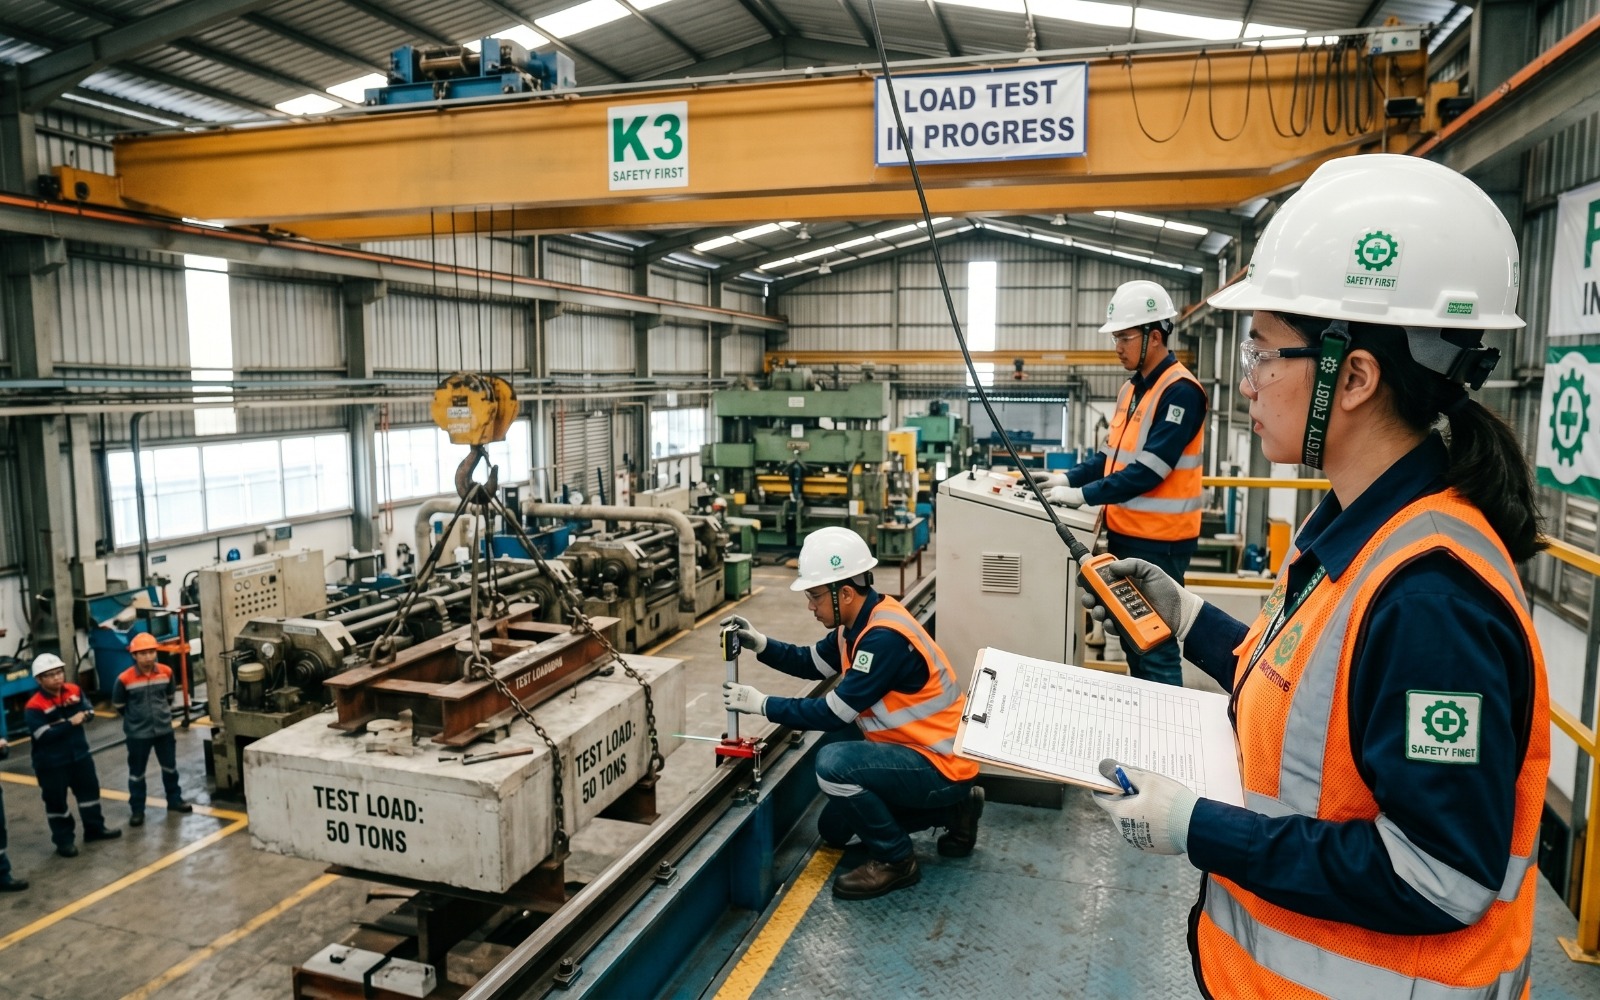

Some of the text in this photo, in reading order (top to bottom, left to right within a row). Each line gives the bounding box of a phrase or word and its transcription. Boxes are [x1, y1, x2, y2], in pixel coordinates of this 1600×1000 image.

[904, 79, 1058, 113] LOAD TEST
[613, 113, 683, 162] K3
[887, 116, 1075, 151] IN PROGRESS
[613, 167, 684, 182] SAFETY FIRST
[1346, 275, 1396, 288] SAFETY FIRST
[515, 671, 532, 690] TEST
[575, 720, 636, 778] TEST LOAD:
[1411, 744, 1450, 757] SAFETY
[582, 753, 627, 804] 50 TONS
[313, 785, 424, 824] TEST LOAD:
[326, 819, 407, 853] 50 TONS
